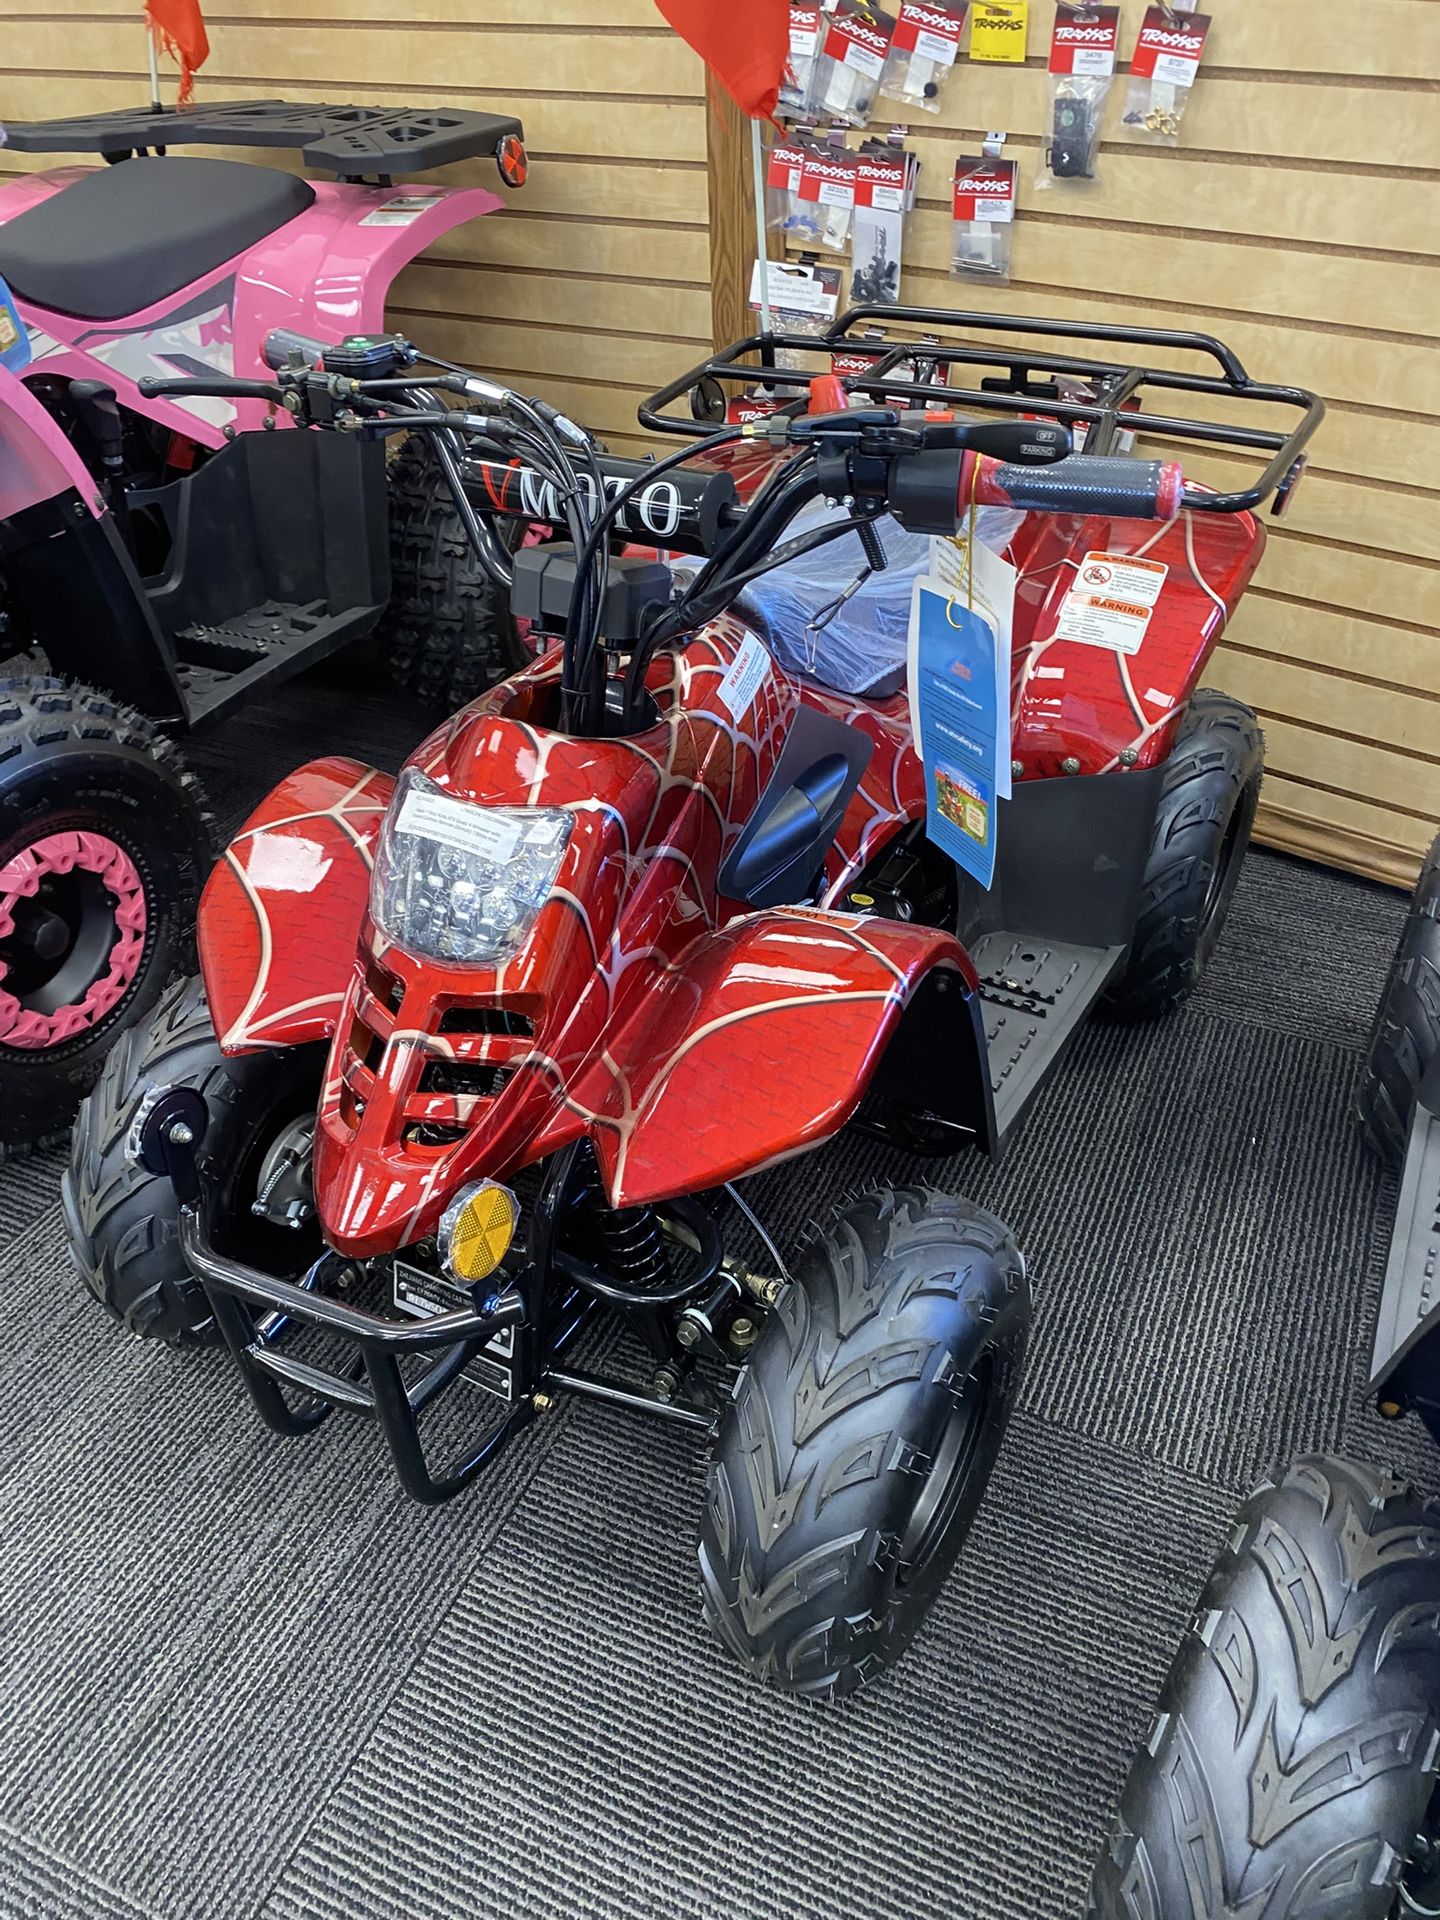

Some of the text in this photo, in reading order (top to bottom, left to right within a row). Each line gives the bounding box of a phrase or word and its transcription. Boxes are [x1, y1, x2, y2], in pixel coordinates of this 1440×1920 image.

[903, 4, 960, 32] TRAXXAS
[974, 18, 1023, 31] TRAXXAS
[1055, 27, 1113, 41] TRAXXAS
[1142, 28, 1203, 49] TRAXXAS
[773, 149, 804, 164] TRAX
[804, 161, 856, 180] TRAXXAS
[857, 166, 902, 180] TRAXXAS
[1039, 431, 1054, 440] OFF
[1022, 445, 1054, 456] PARKING
[1112, 557, 1151, 568] WARNING
[1091, 597, 1144, 616] WARNING
[729, 652, 750, 688] WARNING
